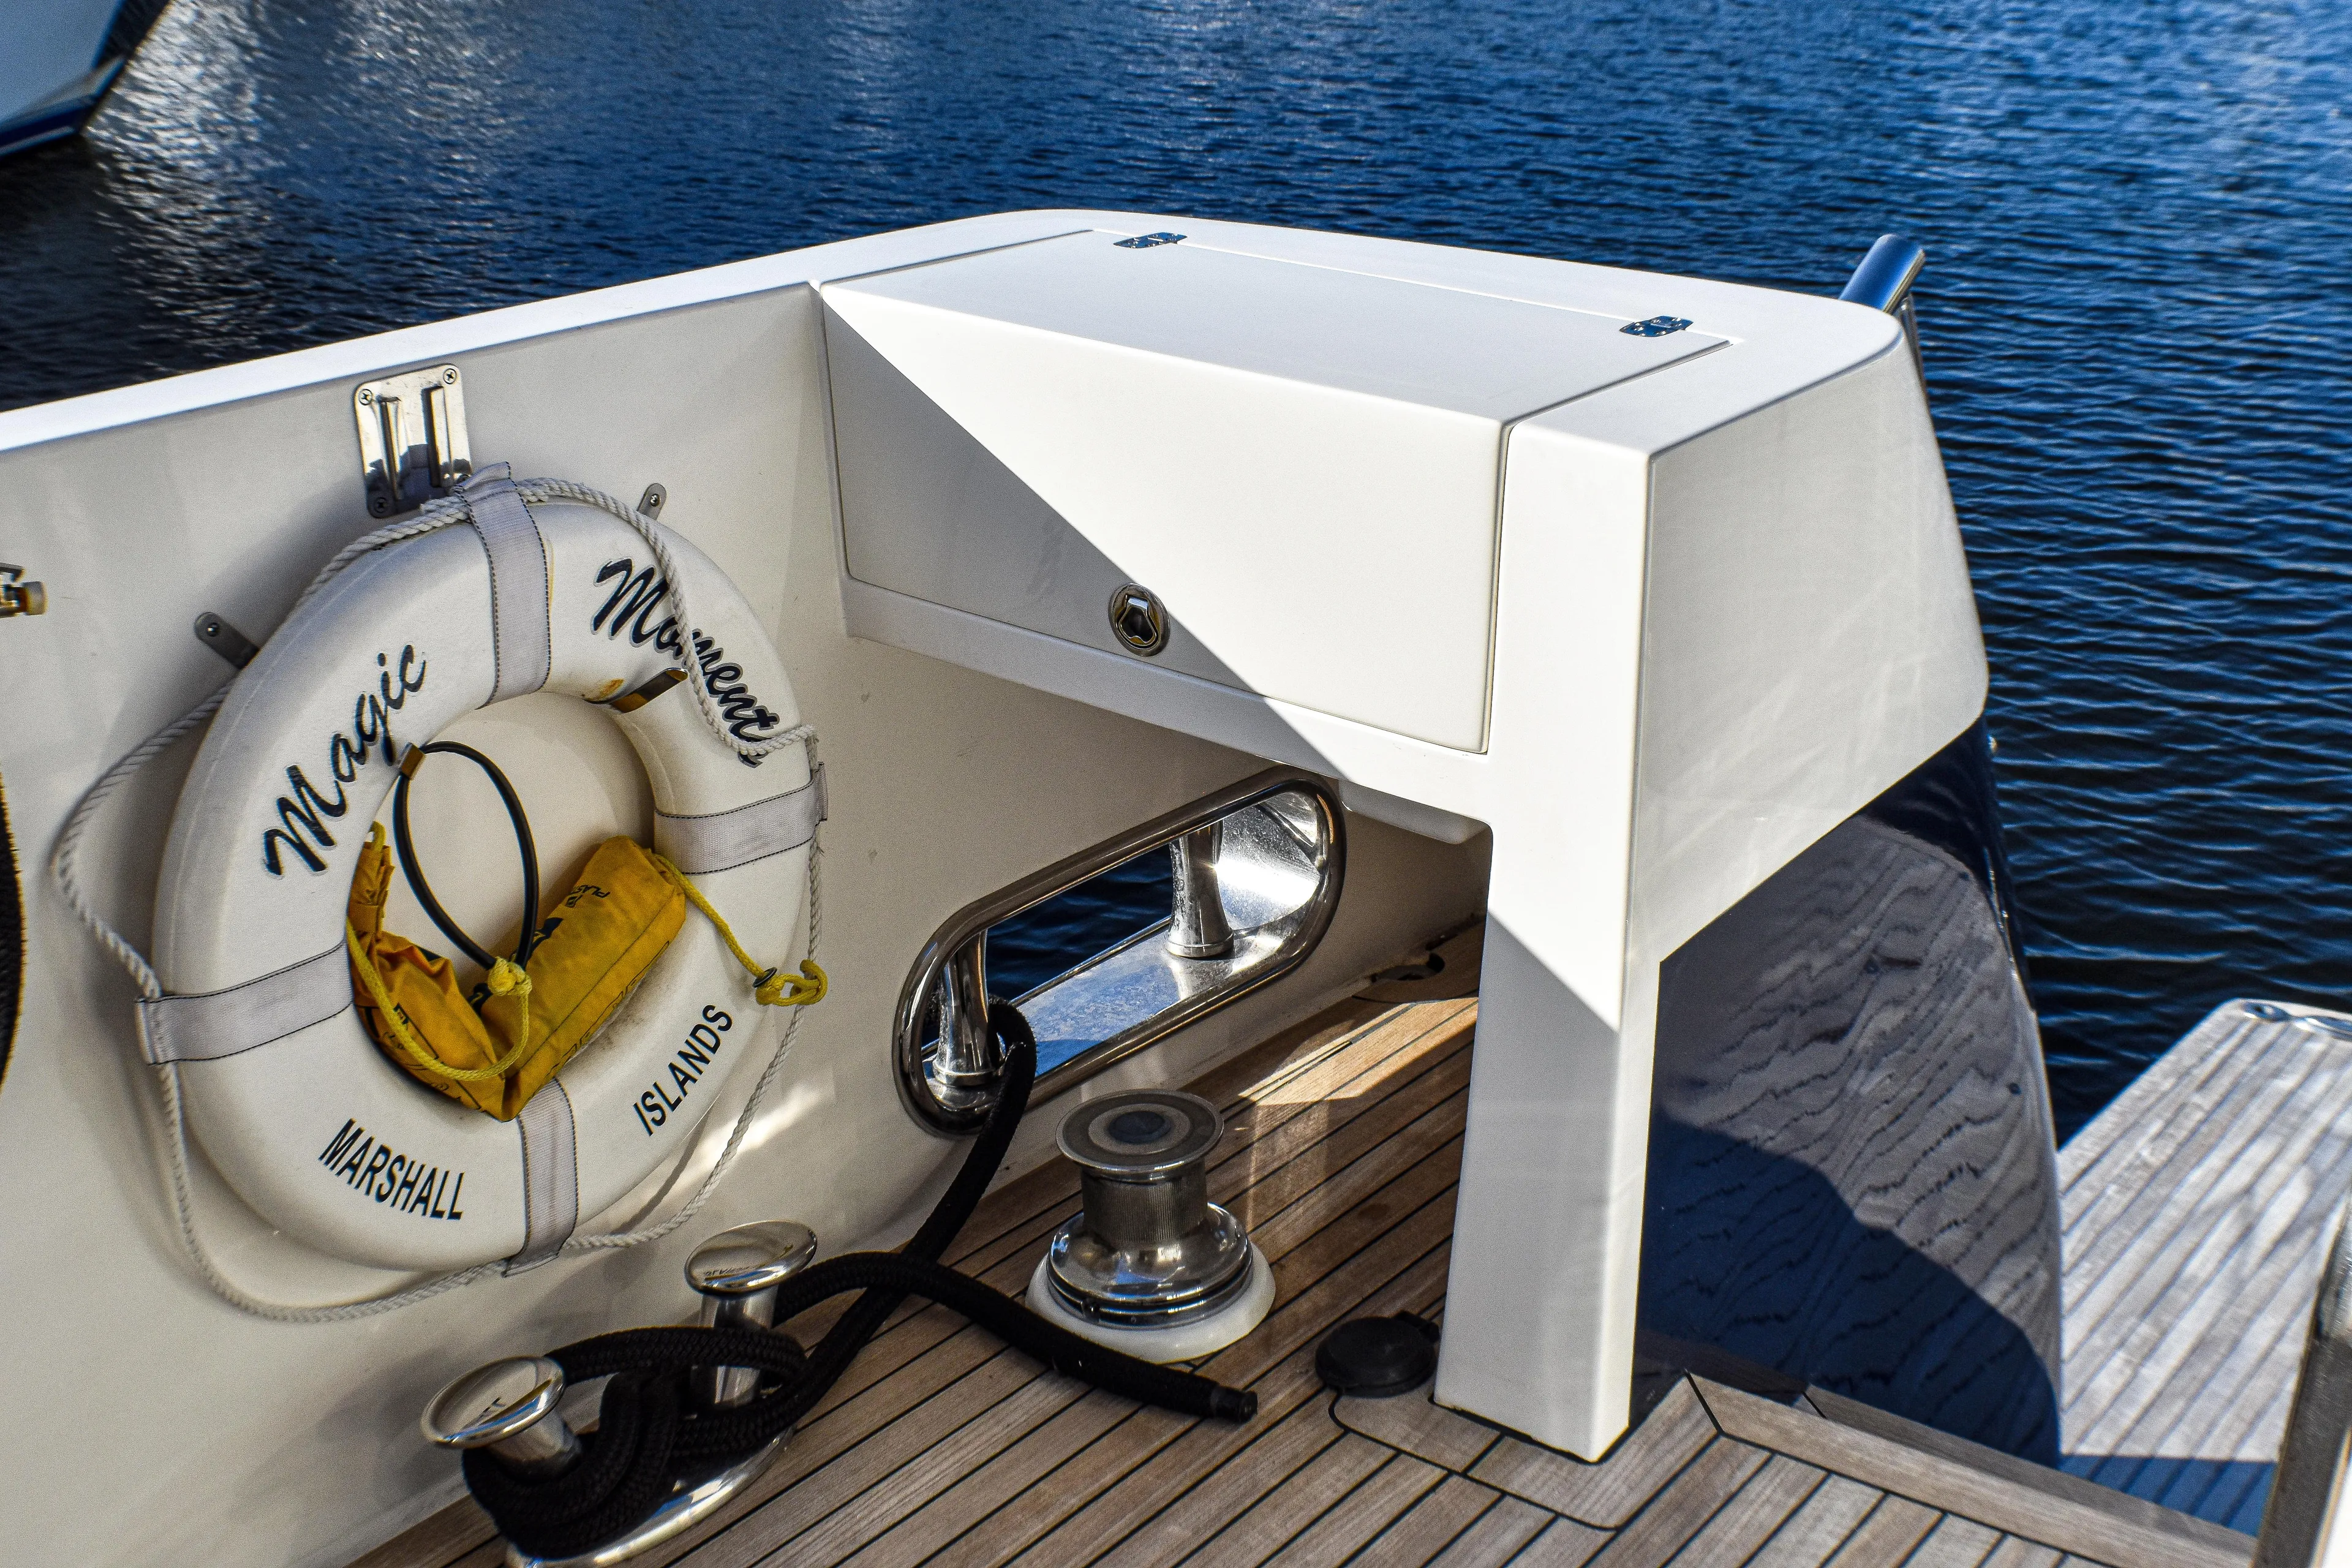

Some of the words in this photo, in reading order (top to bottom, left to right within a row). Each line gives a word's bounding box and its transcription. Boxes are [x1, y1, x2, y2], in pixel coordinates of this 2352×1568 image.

[262, 644, 426, 876] Magic
[318, 1118, 465, 1219] MARSHALL
[633, 1004, 733, 1136] ISLANDS
